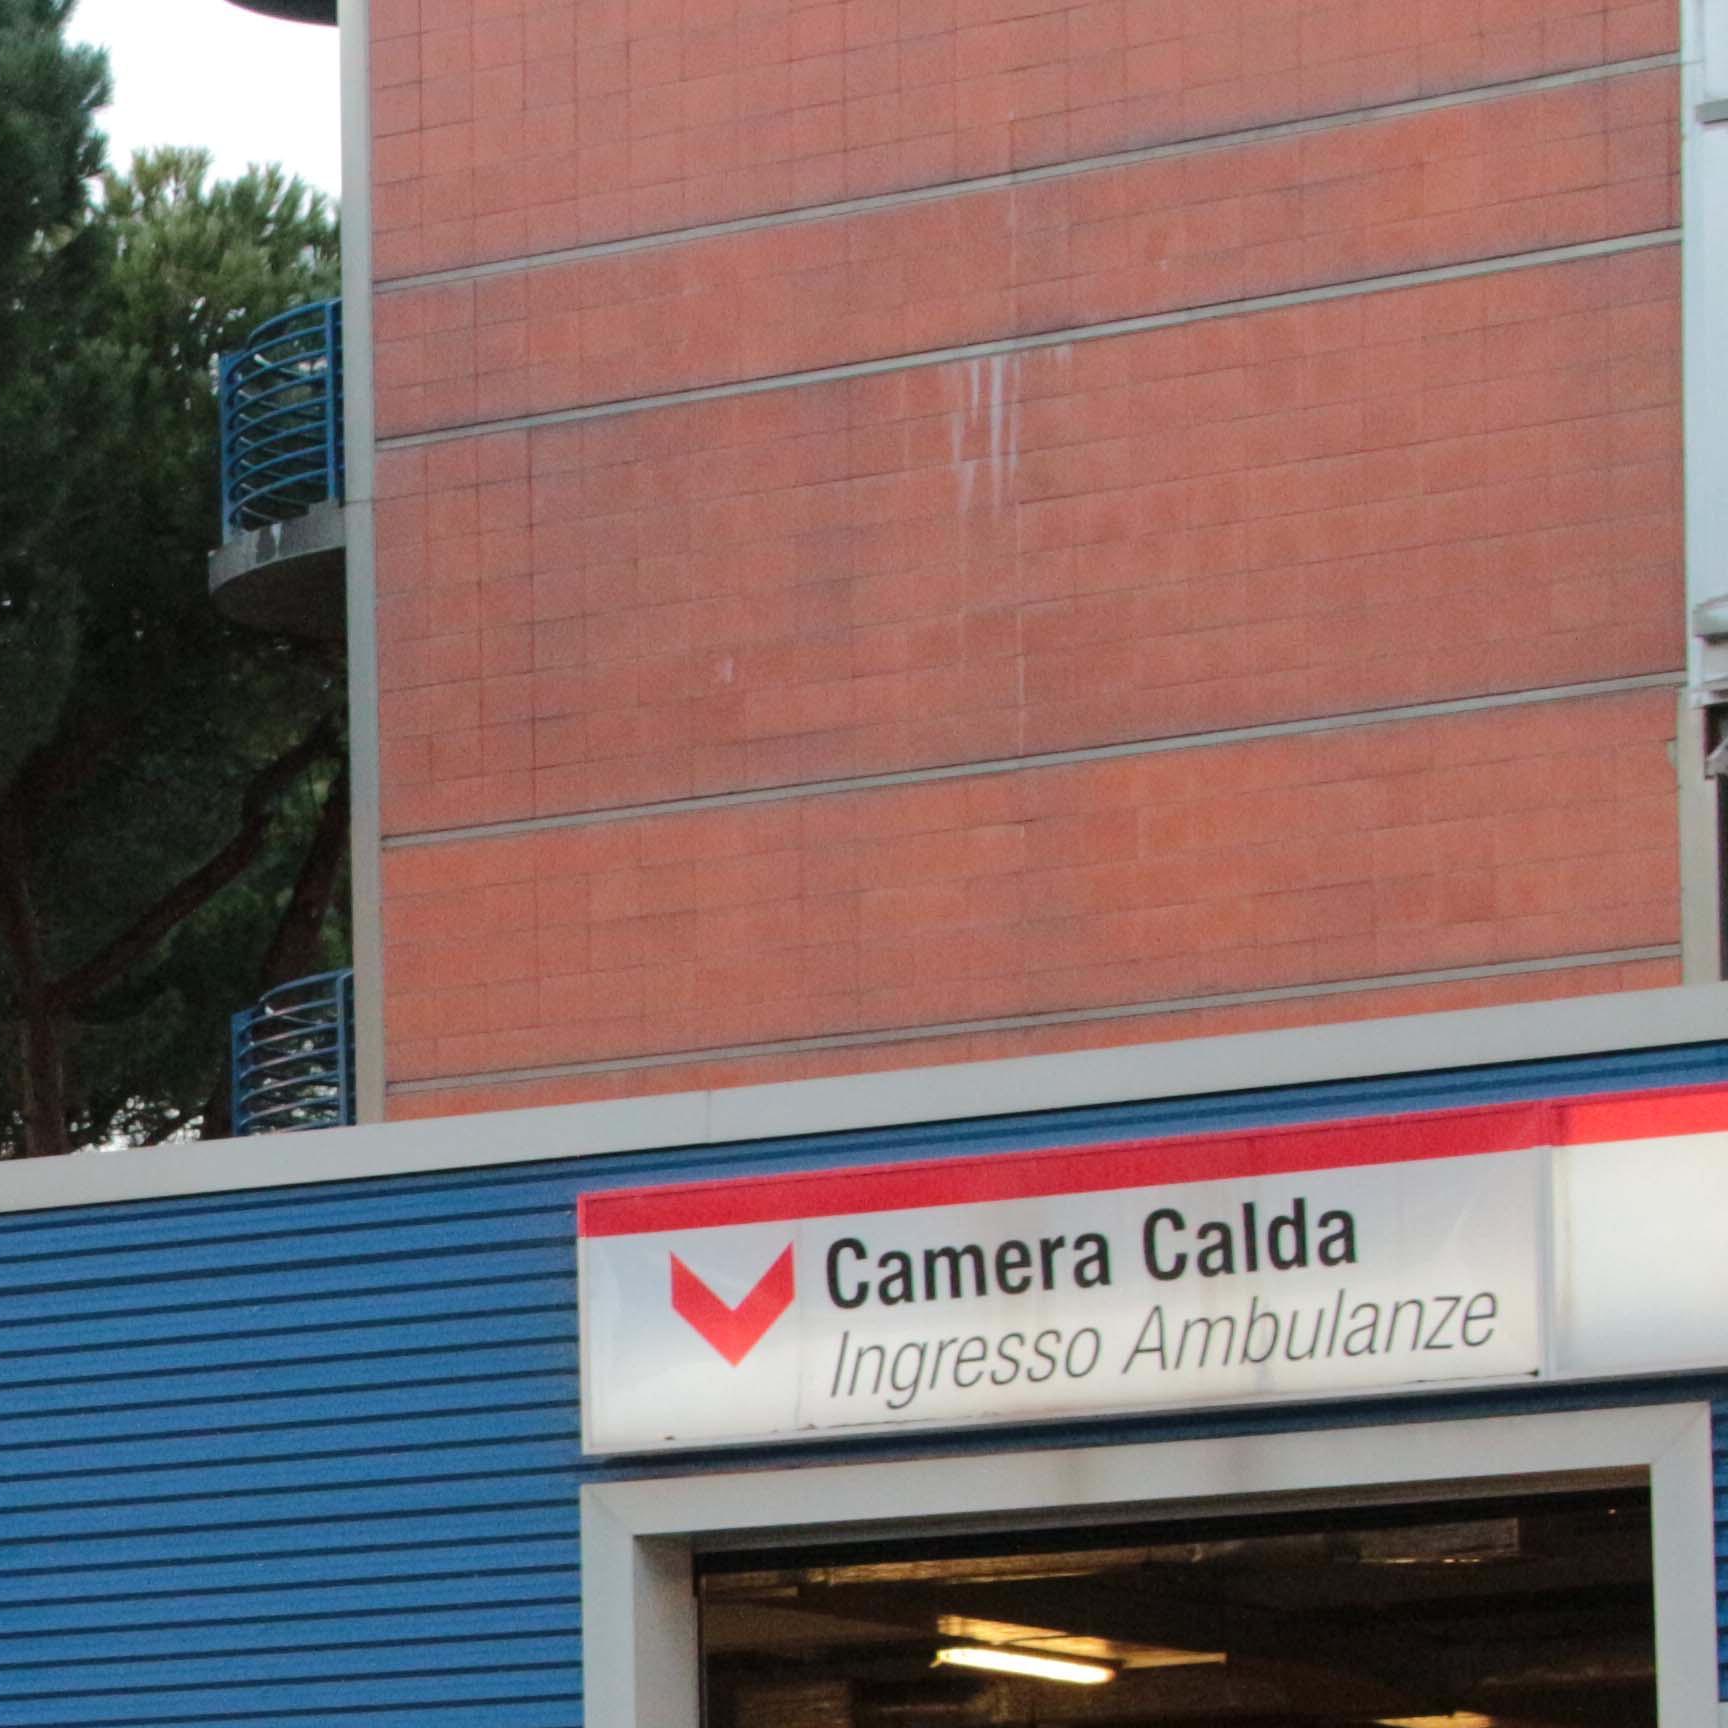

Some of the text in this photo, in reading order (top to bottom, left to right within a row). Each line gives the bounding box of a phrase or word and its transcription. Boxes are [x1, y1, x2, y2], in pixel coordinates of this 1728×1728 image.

[825, 1196, 1359, 1310] Camera Calda
[829, 1286, 1498, 1410] Ingresso Ambulanze
